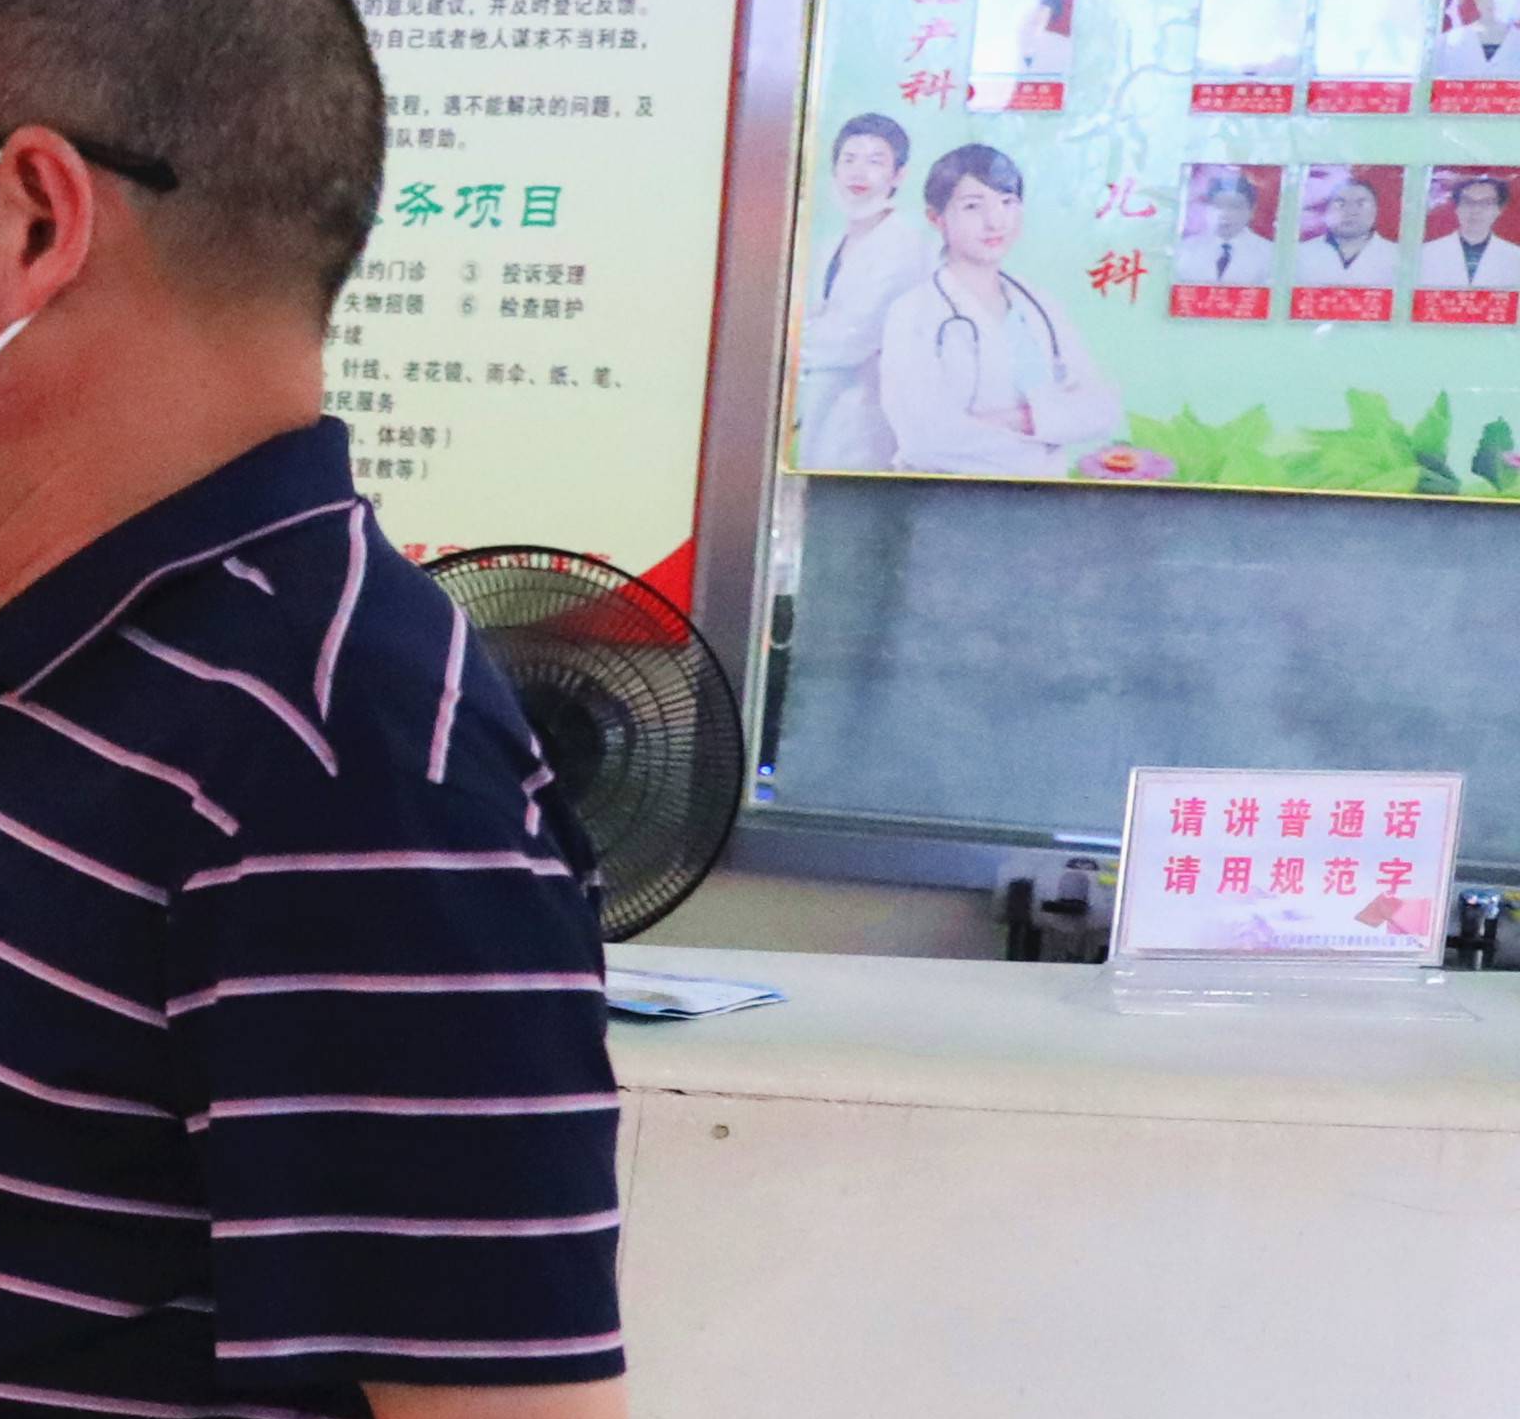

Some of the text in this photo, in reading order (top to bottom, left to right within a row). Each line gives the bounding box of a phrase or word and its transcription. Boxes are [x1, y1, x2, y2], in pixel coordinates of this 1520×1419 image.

[1086, 176, 1158, 304] 儿科
[1169, 796, 1422, 840] 请讲普通话
[1163, 855, 1415, 898] 请用规范字
